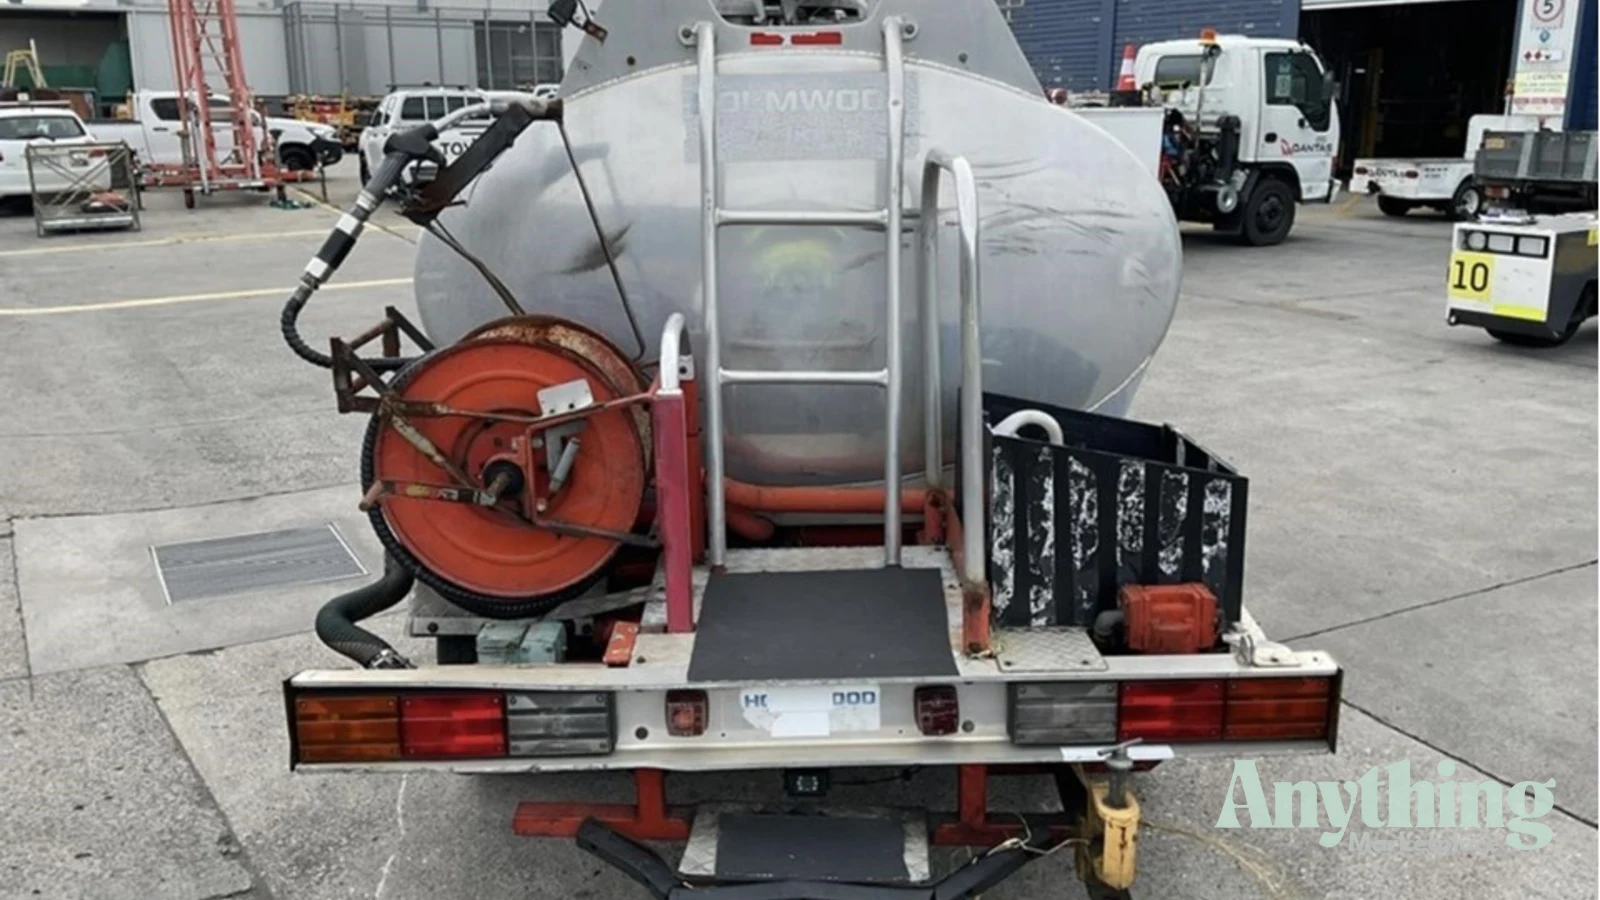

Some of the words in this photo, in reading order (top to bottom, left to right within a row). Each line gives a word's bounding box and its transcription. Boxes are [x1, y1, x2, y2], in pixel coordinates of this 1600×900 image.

[1543, 0, 1554, 14] 5
[1292, 142, 1333, 153] QANTAS
[1453, 260, 1489, 292] 10
